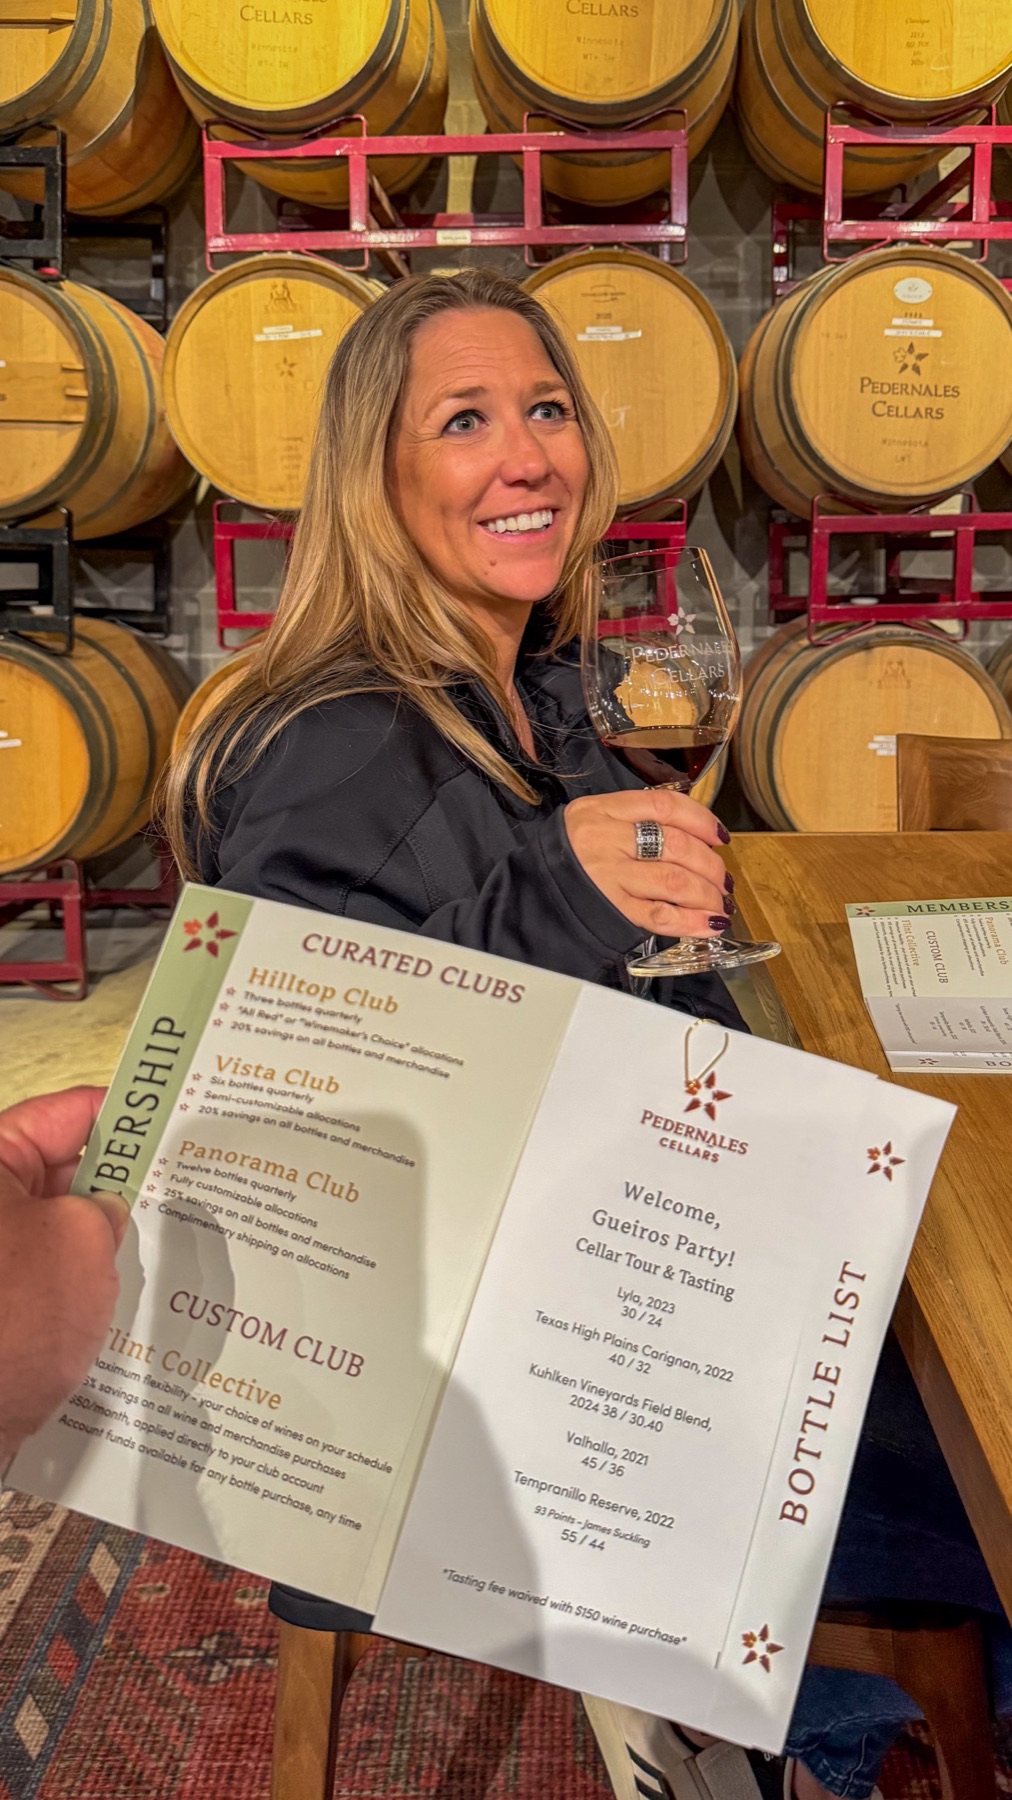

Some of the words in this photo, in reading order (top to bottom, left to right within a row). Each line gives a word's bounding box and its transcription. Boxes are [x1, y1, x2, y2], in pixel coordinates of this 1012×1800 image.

[240, 5, 313, 25] CELLARS
[566, 0, 639, 18] CELLARS
[860, 376, 960, 398] PEDERNALES
[872, 401, 944, 420] CELLARS
[652, 665, 725, 684] CELLARS
[902, 920, 912, 934] Flint
[906, 901, 1012, 913] MEMBERS
[906, 934, 920, 966] Collective
[926, 931, 942, 961] CUSTOM
[935, 962, 948, 983] CLUB
[985, 917, 1001, 948] Panorama
[996, 949, 1008, 965] Club
[248, 967, 336, 1003] Hilltop
[343, 988, 398, 1014] Club
[302, 933, 433, 978] CURATED
[440, 966, 526, 1004] CLUBS
[245, 991, 274, 1004] Three
[276, 998, 312, 1012] bottles
[314, 1007, 362, 1024] quarterly
[231, 1021, 252, 1032] 20%
[254, 1027, 294, 1041] savings
[296, 1035, 310, 1043] on
[312, 1038, 326, 1046] all
[327, 1040, 362, 1055] bottles
[363, 1050, 385, 1061] and
[385, 1056, 450, 1079] merchandise
[410, 1046, 464, 1066] allocations
[210, 1076, 226, 1086] Six
[228, 1079, 264, 1092] bottles
[266, 1087, 314, 1104] quarterly
[217, 1055, 276, 1081] Vista
[284, 1068, 340, 1094] Club
[204, 1090, 304, 1116] Semi-customizable
[306, 1112, 360, 1132] allocations
[640, 1109, 749, 1155] PEDERNALES
[198, 1105, 219, 1116] 20%
[221, 1110, 261, 1123] savings
[263, 1118, 277, 1126] on
[278, 1120, 293, 1129] all
[293, 1122, 328, 1140] bottles
[330, 1134, 352, 1146] and
[351, 1141, 416, 1168] merchandise
[659, 1137, 719, 1163] CELLARS
[177, 1161, 212, 1174] Twelve
[213, 1168, 248, 1185] bottles
[250, 1180, 297, 1202] quarterly
[179, 1140, 298, 1183] Panorama
[306, 1171, 359, 1203] Club
[170, 1174, 194, 1187] Fully
[196, 1181, 263, 1208] customizable
[264, 1203, 318, 1228] allocations
[625, 1181, 720, 1230] Welcome,
[158, 1203, 236, 1239] Complimentary
[236, 1232, 280, 1256] shipping
[281, 1249, 294, 1259] on
[296, 1254, 350, 1280] allocations
[164, 1187, 184, 1200] 25%
[185, 1196, 224, 1217] savings
[225, 1209, 239, 1219] on
[240, 1214, 255, 1224] all
[255, 1218, 289, 1237] bottles
[290, 1232, 312, 1245] and
[312, 1240, 377, 1269] merchandise
[592, 1209, 670, 1247] Gueiros
[675, 1234, 735, 1268] Party!
[576, 1237, 623, 1263] Cellar
[625, 1252, 661, 1275] Tour
[662, 1264, 675, 1281] &
[679, 1269, 735, 1303] Tasting
[617, 1286, 643, 1306] Lyla,
[645, 1296, 676, 1314] 2023
[620, 1305, 637, 1320] 30
[647, 1313, 663, 1328] 24
[170, 1291, 288, 1351] CUSTOM
[294, 1335, 365, 1378] CLUB
[536, 1310, 569, 1331] Texas
[571, 1322, 600, 1341] High
[602, 1332, 639, 1353] Plains
[641, 1344, 701, 1375] Carignan,
[703, 1364, 734, 1383] 2022
[108, 1327, 156, 1363] lint
[162, 1350, 282, 1410] Collective
[608, 1353, 626, 1366] 40
[635, 1360, 651, 1374] 32
[529, 1363, 577, 1388] Kuhlken
[581, 1378, 640, 1408] Vineyards
[641, 1398, 673, 1417] Field
[673, 1408, 712, 1432] Blend,
[569, 1394, 600, 1413] 2024
[602, 1404, 618, 1419] 38
[628, 1412, 664, 1432] 30.40
[778, 1362, 841, 1525] BOTTLE
[822, 1261, 866, 1348] LIST
[98, 1383, 139, 1405] savings
[141, 1399, 155, 1410] on
[157, 1404, 172, 1415] all
[173, 1411, 198, 1426] wine
[200, 1420, 223, 1434] and
[222, 1429, 291, 1460] merchandise
[291, 1454, 346, 1480] purchases
[143, 1375, 190, 1402] flexibility
[198, 1398, 224, 1412] your
[224, 1406, 260, 1426] choice
[260, 1420, 275, 1430] of
[274, 1425, 304, 1442] wines
[305, 1436, 320, 1447] on
[321, 1442, 346, 1456] your
[346, 1451, 393, 1474] schedule
[133, 1419, 176, 1440] applied
[176, 1433, 216, 1457] directly
[218, 1448, 229, 1460] to
[229, 1454, 256, 1469] your
[256, 1463, 280, 1479] club
[281, 1473, 325, 1494] account
[567, 1431, 618, 1460] Valhalla,
[620, 1448, 649, 1466] 2021
[581, 1456, 598, 1469] 45
[608, 1462, 625, 1477] 36
[59, 1414, 104, 1437] Account
[106, 1430, 136, 1450] funds
[138, 1444, 188, 1468] available
[189, 1460, 206, 1474] for
[207, 1469, 228, 1485] any
[228, 1474, 260, 1495] bottle
[260, 1488, 313, 1516] purchase,
[316, 1508, 337, 1523] any
[338, 1514, 362, 1531] time
[514, 1470, 587, 1502] Tempranillo
[589, 1493, 641, 1521] Reserve,
[643, 1510, 675, 1529] 2022
[534, 1505, 547, 1516] 93
[547, 1508, 576, 1524] Points
[580, 1519, 612, 1535] James
[613, 1528, 651, 1548] Suckling
[561, 1528, 578, 1543] 55
[588, 1538, 605, 1551] 44
[488, 1580, 506, 1595] fee
[508, 1589, 550, 1606] waived
[549, 1600, 574, 1614] with
[574, 1605, 601, 1621] $150
[601, 1615, 628, 1630] wine
